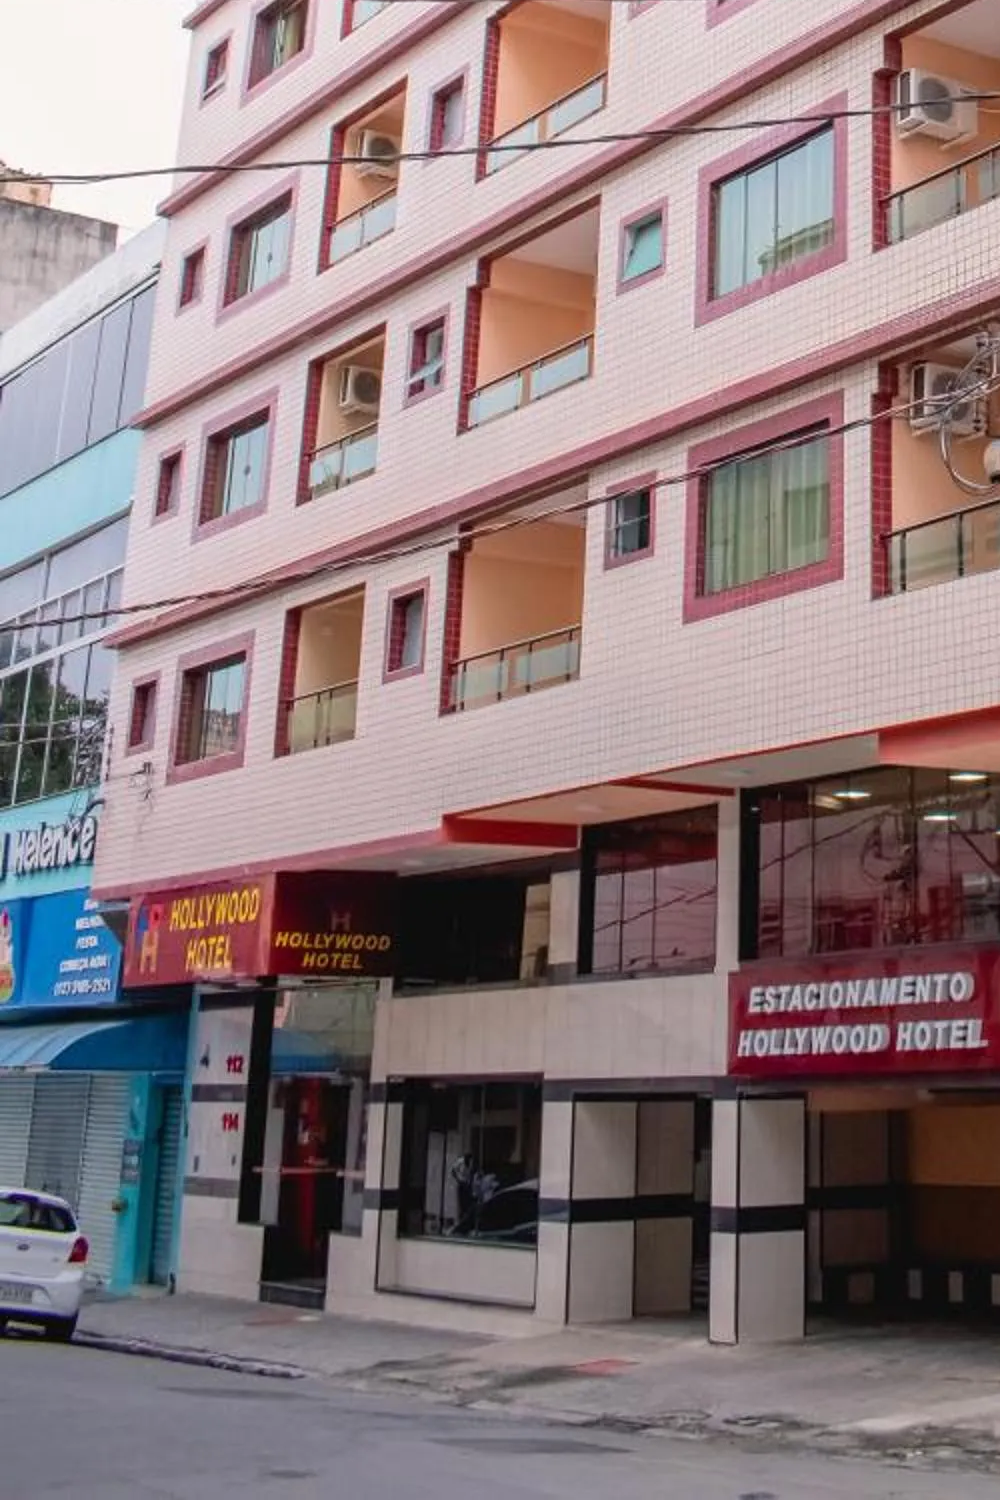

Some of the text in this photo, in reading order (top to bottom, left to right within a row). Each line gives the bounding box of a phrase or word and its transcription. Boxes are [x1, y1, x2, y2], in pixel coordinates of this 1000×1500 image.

[14, 815, 97, 875] Helenice
[170, 888, 260, 931] HOLLYWOOD
[185, 935, 233, 973] HOTEL
[275, 931, 391, 951] HOLLYWOOD
[302, 953, 363, 969] HOTEL
[748, 972, 974, 1014] ESTACIONAMENTO
[737, 1019, 988, 1057] HOLLYWOOD HOTEL
